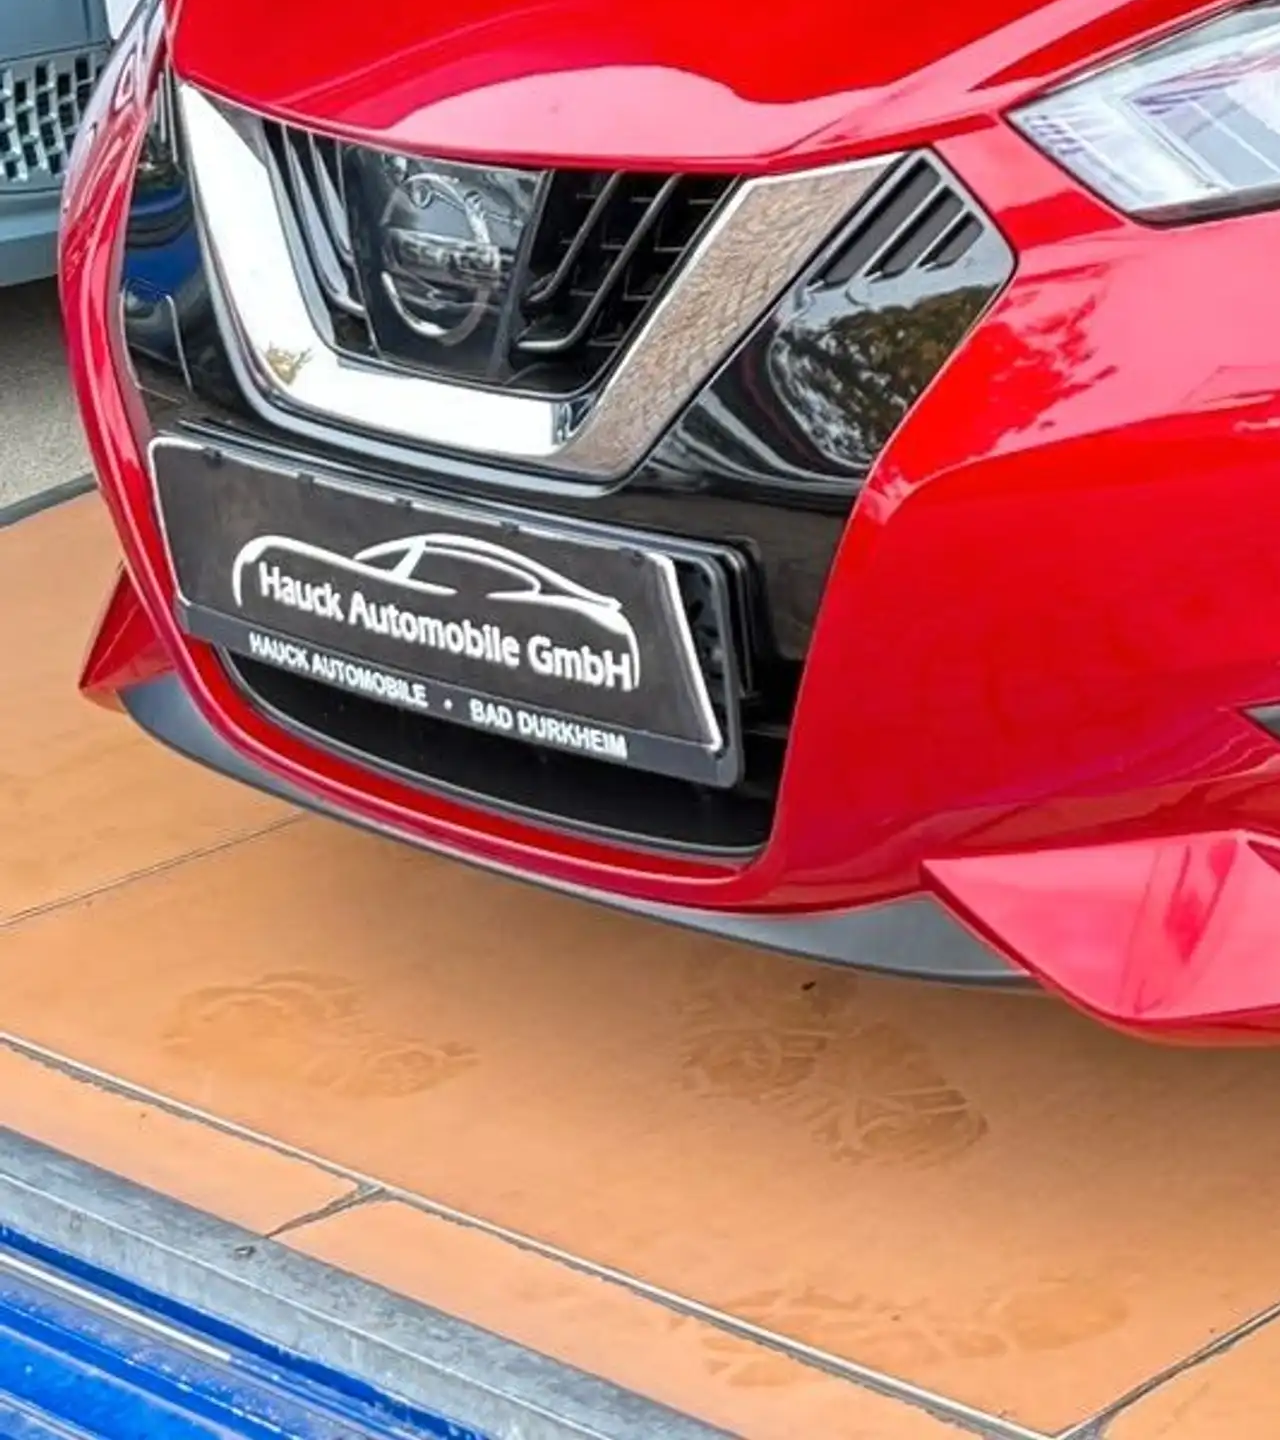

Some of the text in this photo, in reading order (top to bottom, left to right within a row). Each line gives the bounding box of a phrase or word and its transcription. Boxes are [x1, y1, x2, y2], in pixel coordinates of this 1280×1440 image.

[258, 561, 633, 691] Hauck Automobile GmbH
[248, 633, 628, 760] HAUCK AUTOMOBILE BAD DURKHEIM
